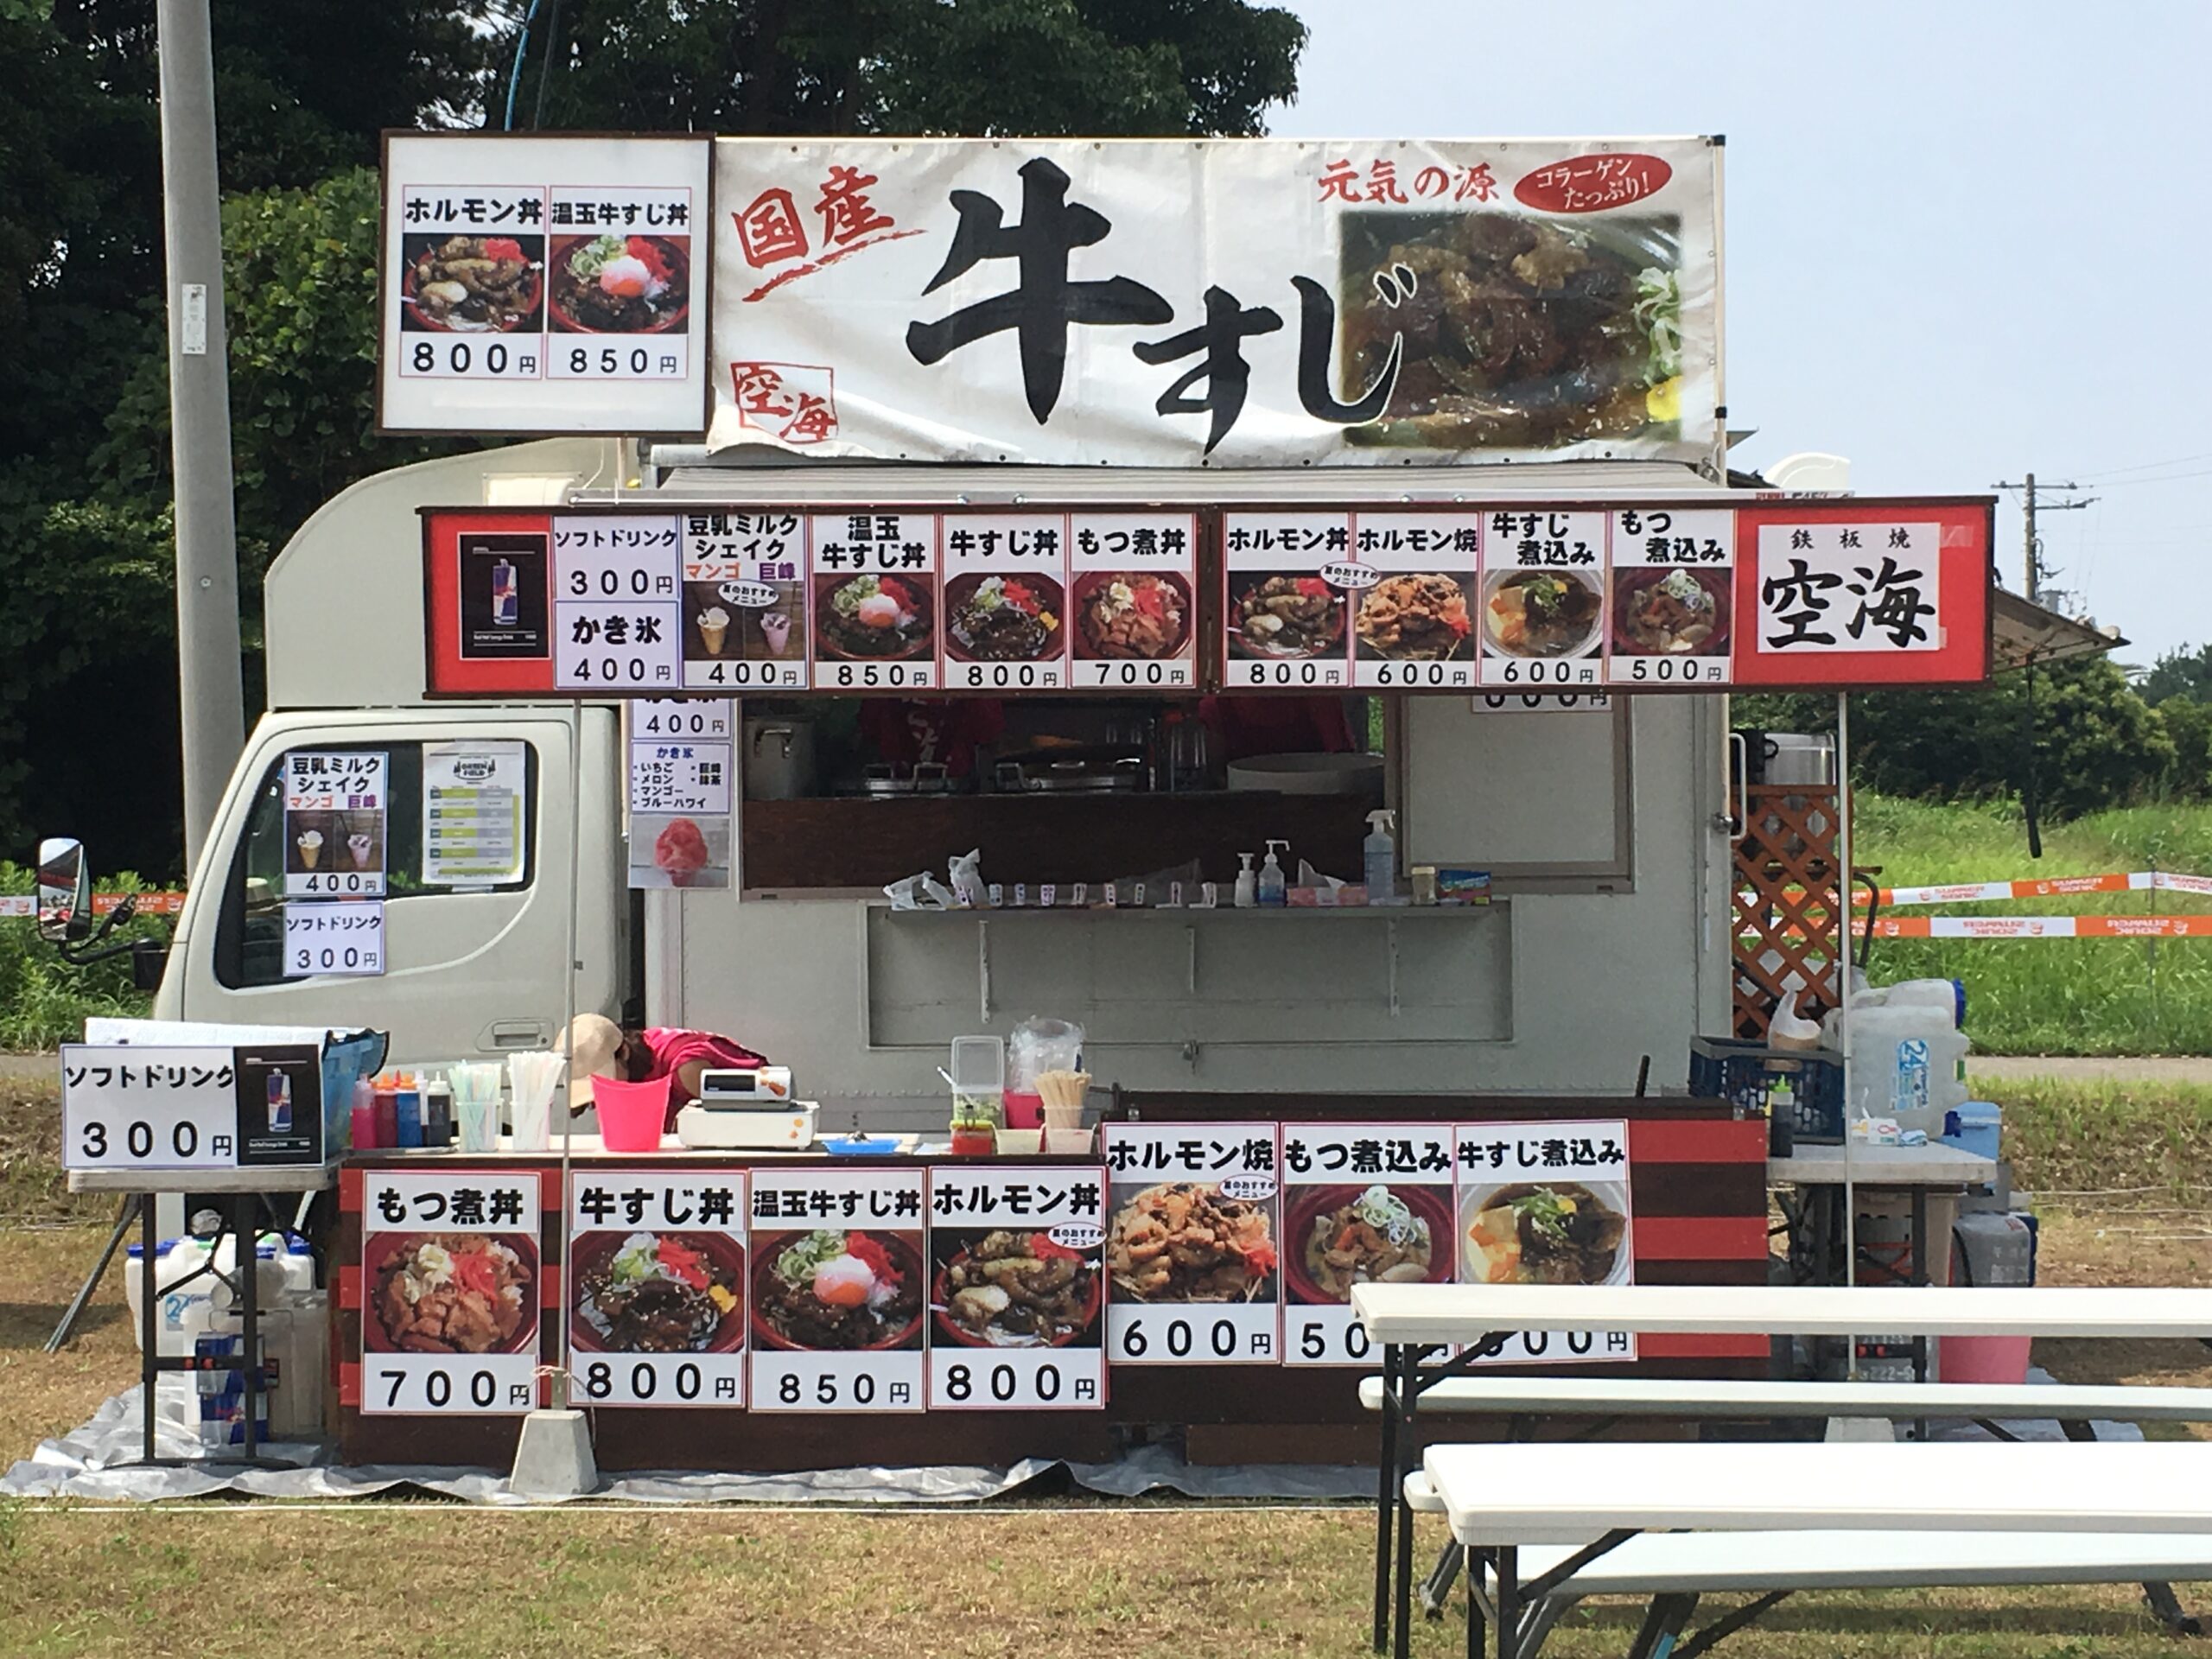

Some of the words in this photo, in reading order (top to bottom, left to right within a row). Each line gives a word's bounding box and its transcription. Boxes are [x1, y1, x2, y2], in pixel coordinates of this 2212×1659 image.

[1319, 162, 1499, 206] 元気の源
[1537, 158, 1632, 188] コラーゲン
[404, 198, 543, 224] ホルモン丼
[551, 202, 689, 226] 温玉牛すじ丼
[732, 166, 895, 269] 国産
[906, 157, 1417, 455] 牛すじ
[412, 342, 536, 373] 800円
[569, 347, 677, 373] 850円
[736, 366, 836, 442] 空海
[688, 514, 798, 537] 豆乳ミルク
[848, 515, 899, 542] 温玉
[1492, 513, 1569, 537] 牛すじ
[1621, 511, 1671, 536] もつ
[554, 530, 677, 547] ソフトドリンク
[696, 540, 785, 560] シェイク
[950, 531, 1058, 556] 牛すじ丼
[1077, 529, 1185, 556] もつ煮丼
[1228, 528, 1349, 551] ホルモン丼
[1357, 528, 1477, 551] ホルモン焼
[1645, 537, 1726, 563] 煮込み
[1791, 528, 1911, 550] 鉄板焼
[822, 543, 925, 569] 牛すじ丼
[1516, 539, 1595, 565] 煮込み
[570, 570, 673, 595] 300円
[686, 563, 741, 580] マンゴ
[759, 563, 795, 581] 巨峰
[1762, 556, 1936, 648] 空海
[571, 616, 662, 645] かき氷
[574, 658, 671, 681] 400円
[709, 663, 797, 684] 400円
[837, 665, 927, 686] 850円
[967, 665, 1057, 686] 800円
[1096, 664, 1185, 684] 700円
[1249, 664, 1339, 684] 800円
[1377, 664, 1466, 684] 600円
[1504, 662, 1593, 683] 600円
[1632, 659, 1721, 680] 500円
[646, 715, 725, 734] 400円
[657, 747, 695, 759] かき氷
[292, 757, 380, 775] 豆乳ミルク
[641, 762, 675, 773] いちご
[297, 777, 371, 794] シェイク
[641, 776, 674, 785] メロン
[641, 786, 683, 796] マンゴー
[289, 795, 334, 809] マンゴ
[347, 794, 377, 809] 巨峰
[641, 798, 707, 809] ブルーハワイ
[306, 874, 377, 893] 400円
[286, 915, 382, 931] ソフトドリンク
[297, 948, 377, 969] 300円
[66, 1064, 233, 1089] ソフトドリンク
[82, 1121, 232, 1158] 300円
[1106, 1140, 1275, 1172] ホルモン焼
[1285, 1140, 1452, 1173] もつ煮込み
[1458, 1138, 1625, 1168] 牛すじ煮込み
[378, 1187, 524, 1225] もつ煮丼
[580, 1187, 734, 1225] 牛すじ丼
[753, 1190, 921, 1217] 温玉牛すじ丼
[933, 1183, 1100, 1216] ホルモン丼
[1124, 1319, 1271, 1357] 600円
[380, 1370, 530, 1407] 700円
[588, 1362, 735, 1399] 800円
[779, 1373, 910, 1403] 850円
[947, 1364, 1096, 1401] 800円
